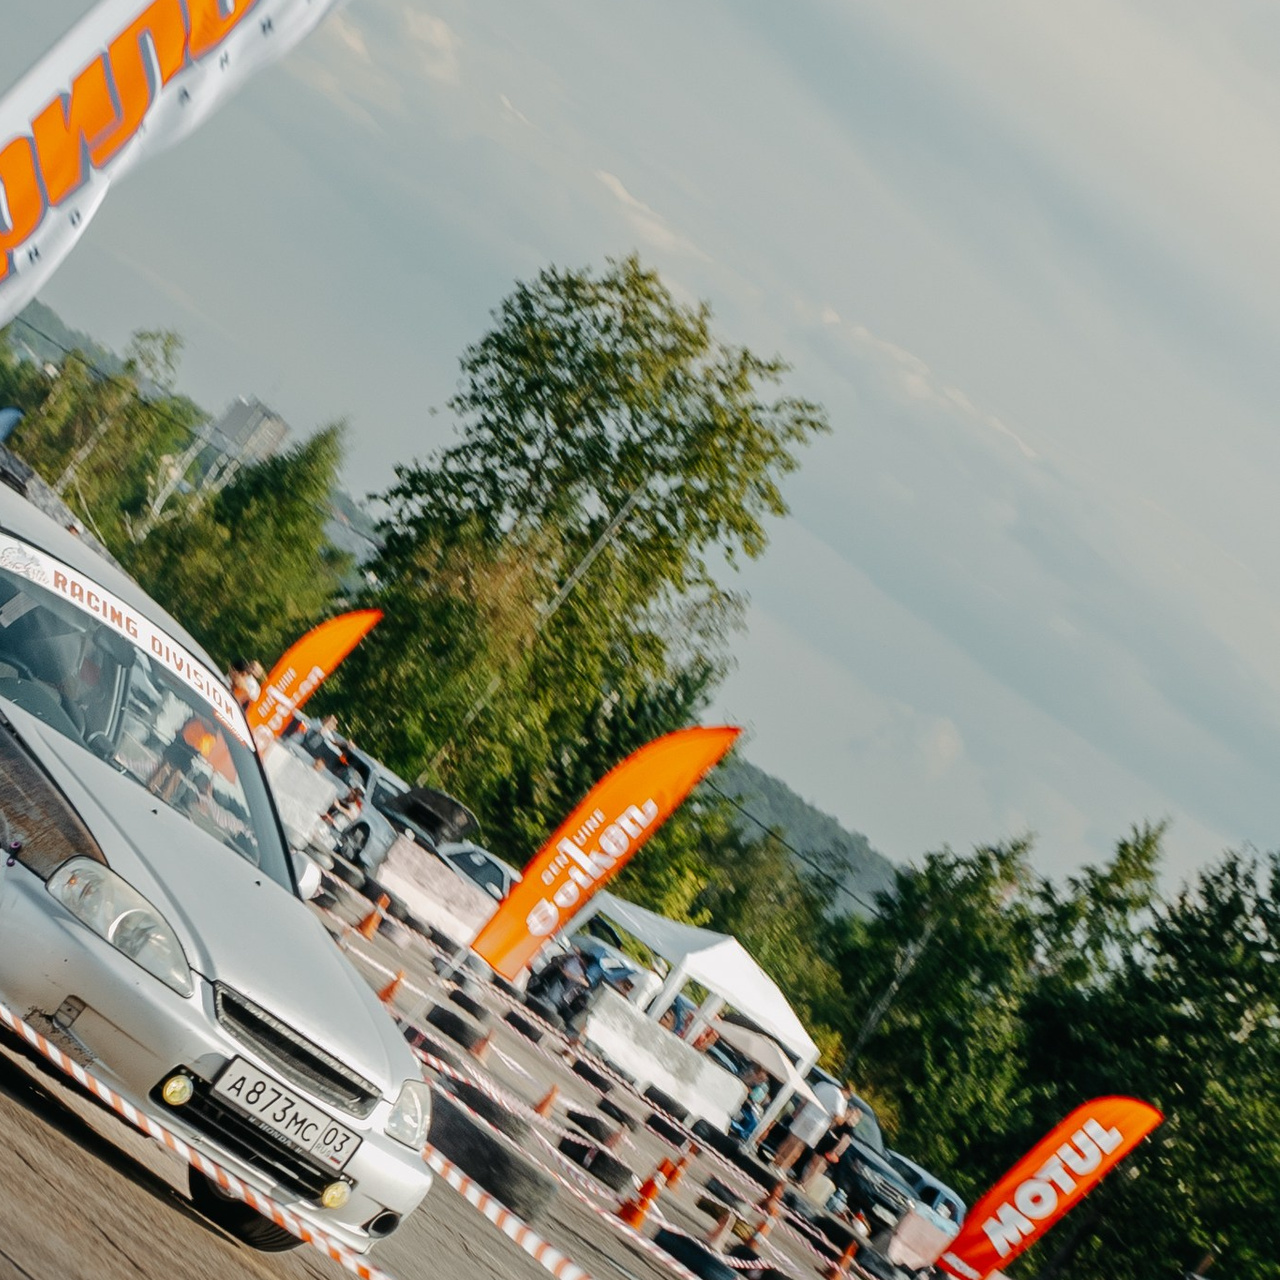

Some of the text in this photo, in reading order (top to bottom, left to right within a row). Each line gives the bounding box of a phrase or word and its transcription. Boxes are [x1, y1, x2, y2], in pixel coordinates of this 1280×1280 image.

[53, 569, 235, 720] RACING DIVISION
[258, 1122, 293, 1147] HONDA
[322, 1126, 350, 1153] 03
[313, 1142, 332, 1158] RUS
[981, 1117, 1124, 1258] MOTUL
